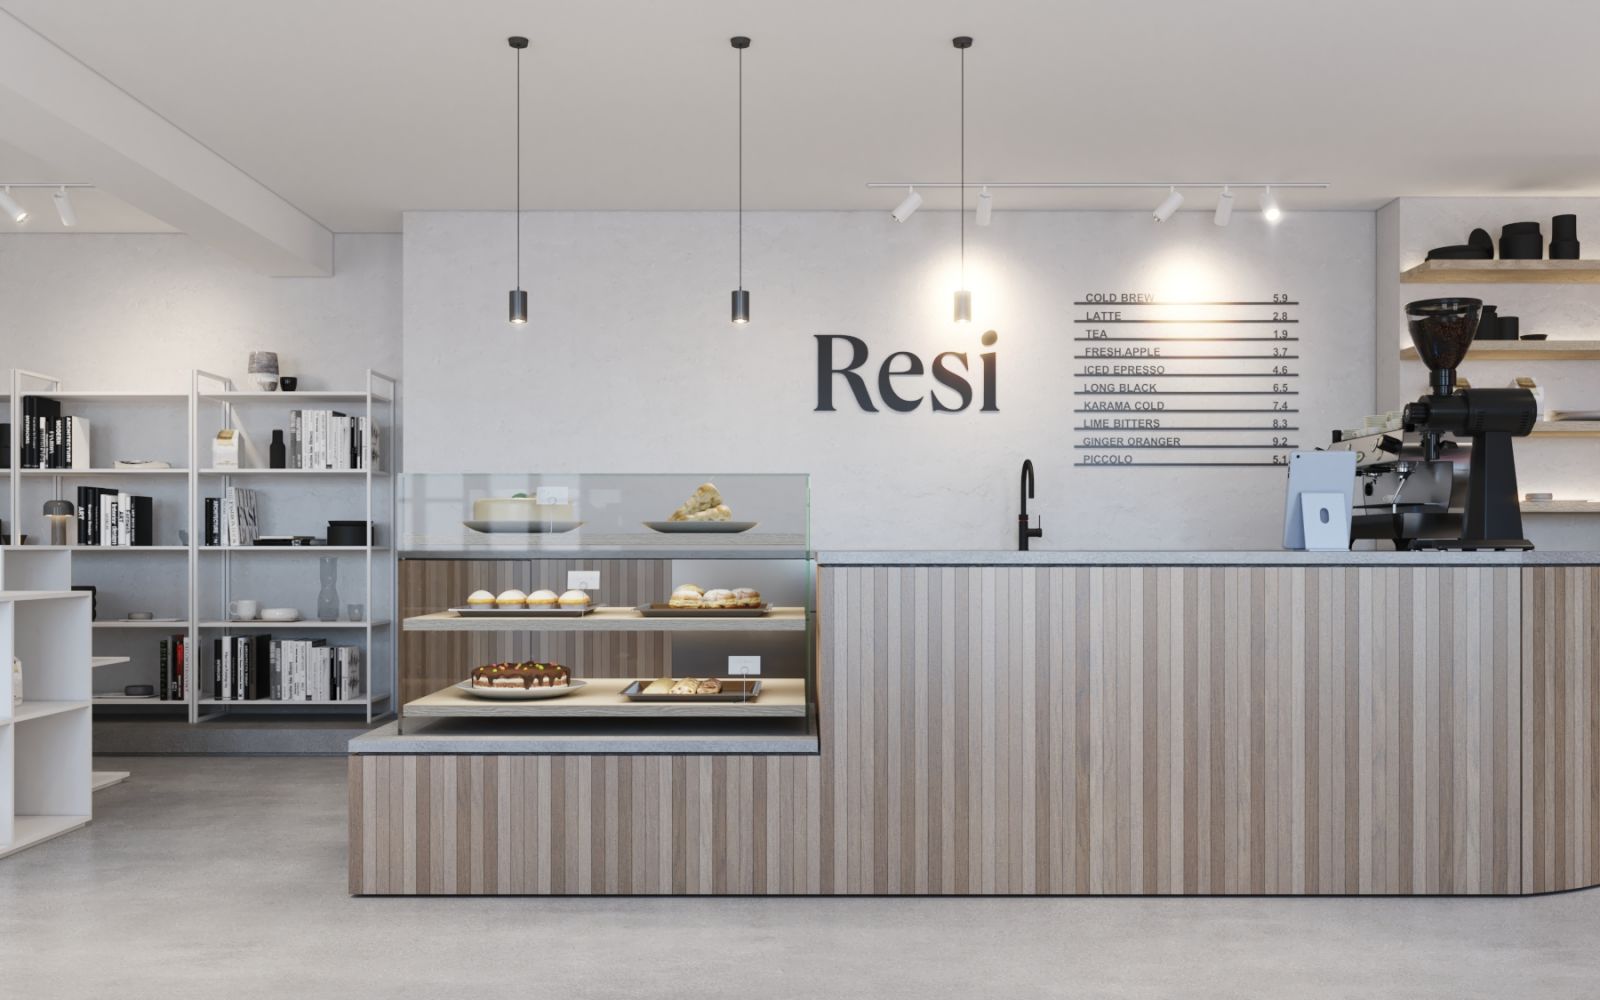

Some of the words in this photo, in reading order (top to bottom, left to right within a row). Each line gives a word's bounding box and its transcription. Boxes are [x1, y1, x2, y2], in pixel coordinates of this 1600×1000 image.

[1085, 293, 1117, 303] COLD
[1121, 293, 1154, 303] BREW
[1273, 293, 1288, 303] 5.9
[1086, 311, 1122, 321] LATTE
[1273, 312, 1288, 321] 2.8
[1086, 329, 1108, 339] TEA
[1273, 330, 1288, 339] 1.9
[1273, 348, 1288, 357] 3.7
[813, 330, 1000, 413] Resi
[1084, 365, 1109, 375] ICED
[1113, 365, 1165, 375] EPRESSO
[1273, 366, 1288, 375] 4.6
[1084, 383, 1115, 393] LONG
[1119, 383, 1157, 393] BLACK
[1273, 384, 1288, 393] 6.5
[1084, 401, 1131, 411] KARAMA
[1134, 401, 1165, 411] COLD
[1273, 401, 1288, 411] 7.4
[1083, 419, 1109, 429] LIME
[1113, 419, 1160, 429] BITTERS
[1273, 419, 1288, 429] 8.3
[1083, 437, 1124, 447] GINGER
[1127, 437, 1181, 447] ORANGER
[1273, 437, 1288, 447] 9.2
[1083, 455, 1133, 465] PICCOLO
[1273, 455, 1287, 465] 5.1
